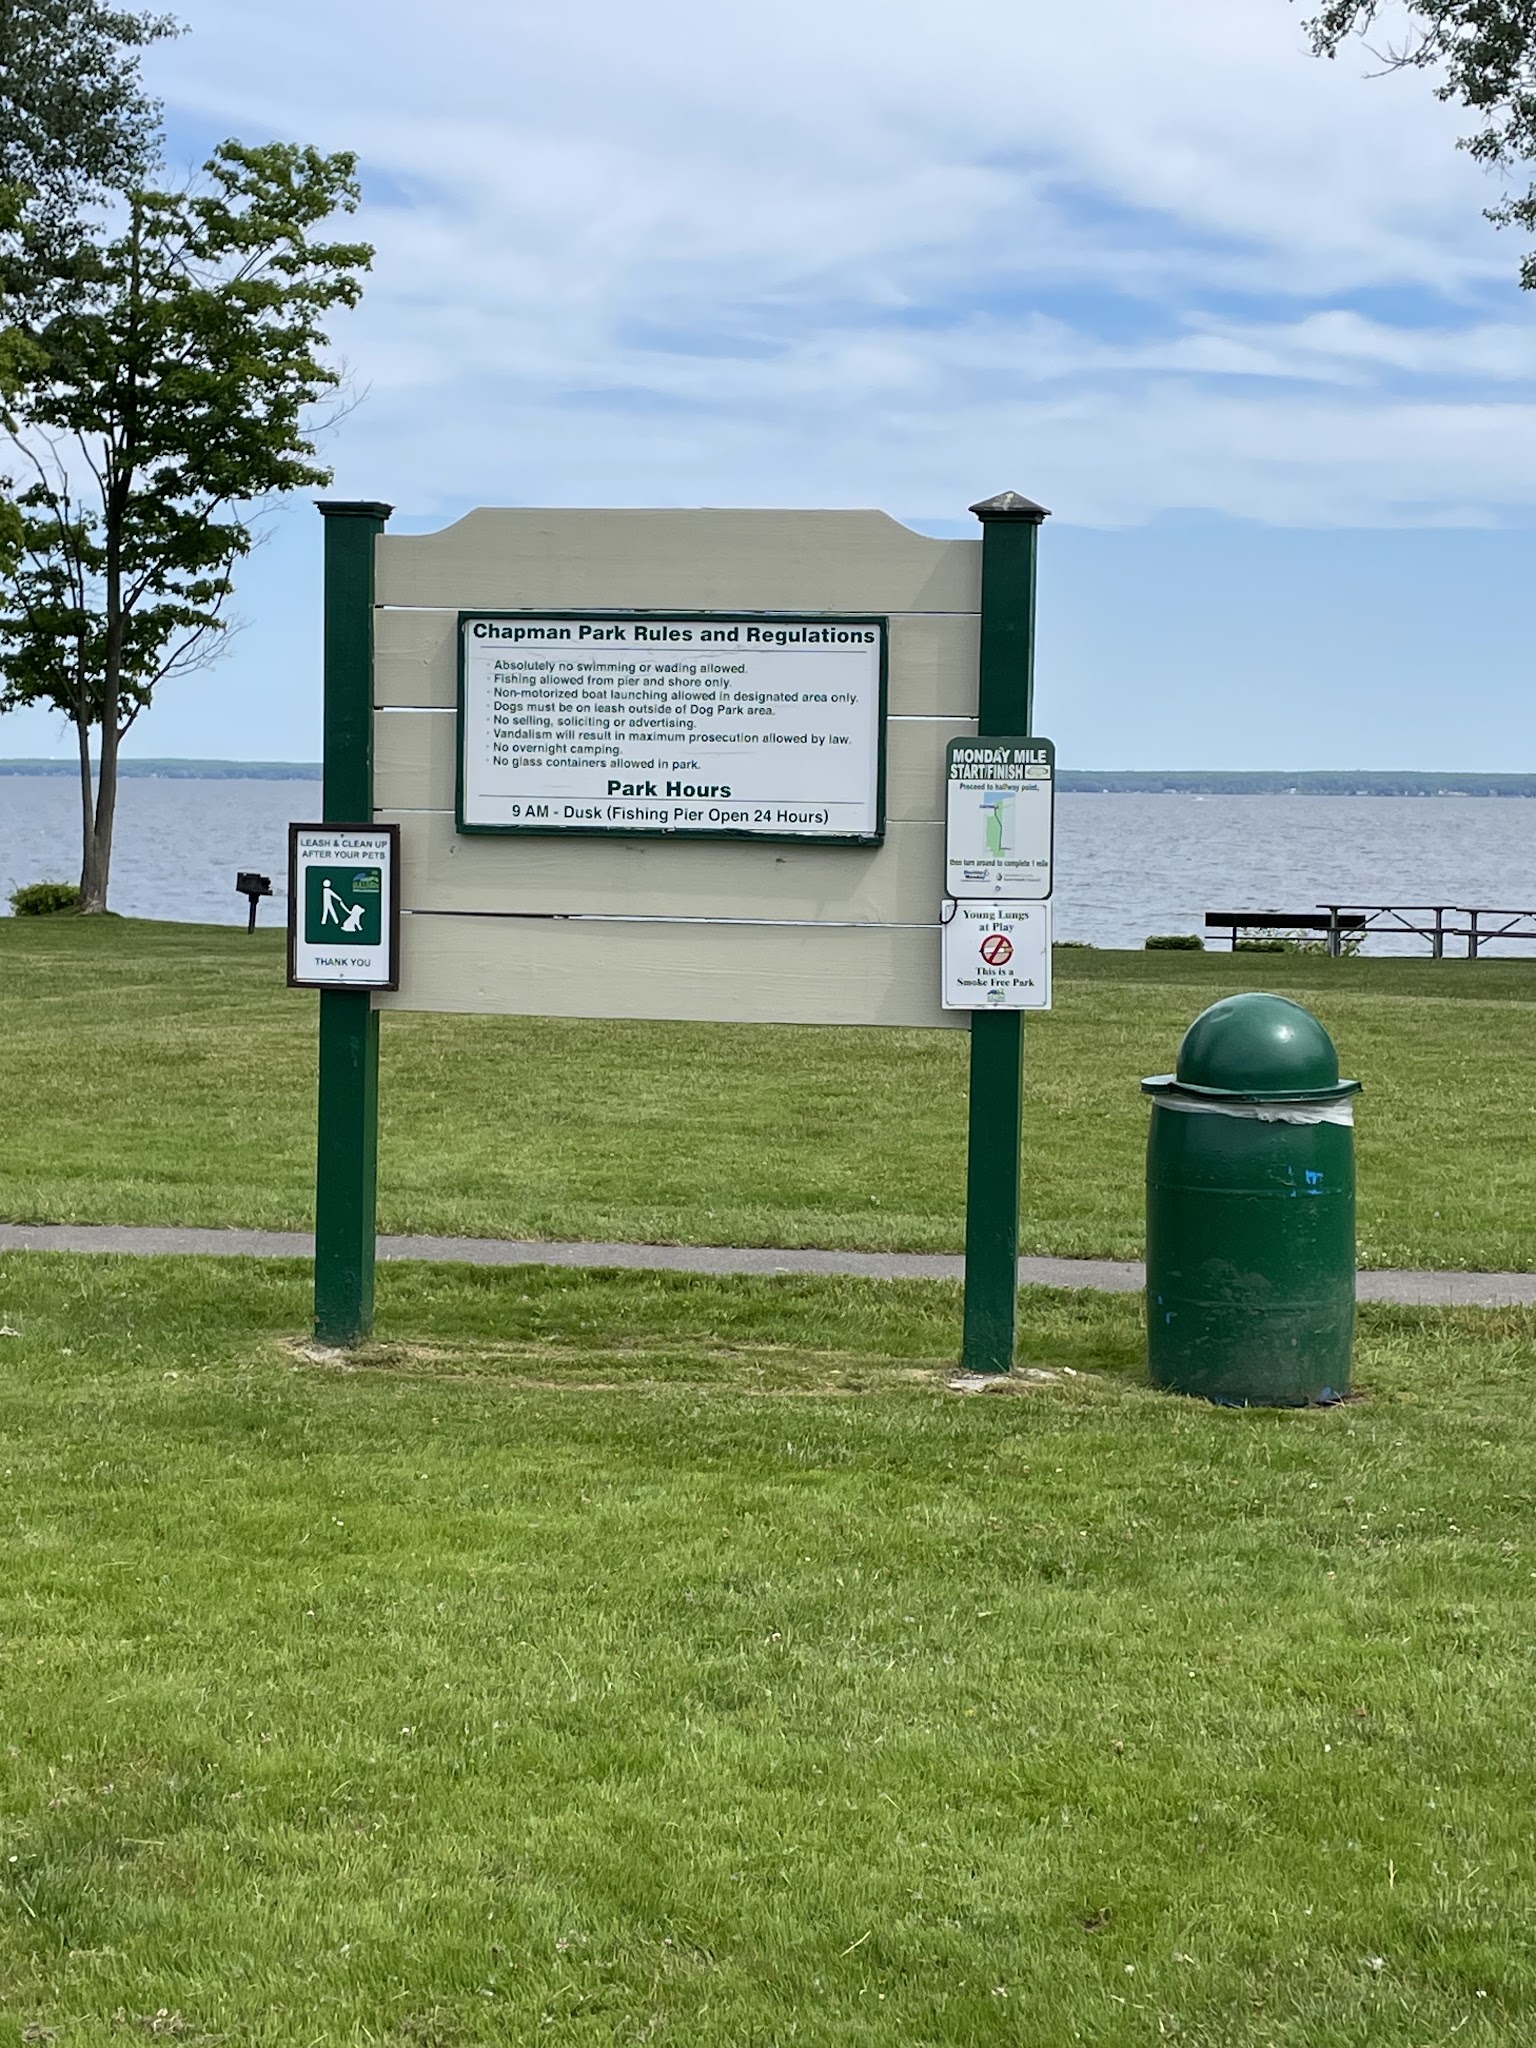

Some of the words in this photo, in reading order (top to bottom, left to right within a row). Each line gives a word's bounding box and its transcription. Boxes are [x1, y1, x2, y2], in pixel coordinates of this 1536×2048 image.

[473, 623, 571, 642] Chapman
[579, 625, 626, 640] Park
[634, 626, 693, 641] Rules
[701, 627, 739, 642] and
[747, 627, 875, 645] Regulations
[494, 660, 555, 673] Absolutely
[577, 662, 635, 674] swimming
[639, 664, 651, 672] or
[655, 663, 696, 675] wading
[700, 664, 748, 673] allowed.
[494, 674, 536, 686] Fishing
[540, 675, 583, 685] allowed
[587, 676, 613, 685] from
[618, 677, 639, 687] pier
[644, 677, 664, 686] and
[669, 678, 701, 686] shore
[705, 678, 731, 689] only.
[494, 688, 578, 699] Non-motorized
[582, 689, 607, 699] boat
[611, 690, 667, 702] launching
[671, 691, 715, 700] allowed
[720, 691, 729, 701] in
[734, 692, 798, 703] designated
[802, 694, 827, 702] area
[494, 702, 523, 713] Dogs
[527, 703, 555, 712] must
[559, 703, 573, 712] be
[595, 704, 624, 713] leash
[629, 705, 671, 714] outside
[675, 705, 687, 714] of
[691, 705, 713, 716] Dog
[718, 705, 743, 715] Park
[747, 707, 775, 715] area.
[494, 716, 509, 724] No
[513, 716, 553, 727] selling,
[558, 717, 609, 728] soliciting
[629, 718, 696, 730] advertising.
[494, 729, 552, 739] Vandalism
[556, 730, 574, 739] will
[579, 731, 611, 740] result
[615, 732, 625, 740] in
[629, 733, 685, 741] maximum
[689, 732, 759, 744] prosecution
[762, 733, 807, 743] allowed
[811, 734, 825, 746] by
[829, 735, 851, 744] law.
[493, 743, 508, 752] No
[513, 743, 567, 755] overnight
[570, 745, 622, 756] camping.
[953, 749, 1010, 763] MONDAY
[1015, 750, 1046, 763] MILE
[493, 756, 508, 765] No
[512, 757, 542, 768] glass
[546, 758, 606, 768] containers
[610, 759, 654, 768] allowed
[659, 759, 668, 768] in
[672, 760, 700, 771] park.
[608, 780, 657, 796] Park
[667, 782, 731, 797] Hours
[512, 805, 520, 816] 9
[525, 805, 549, 817] AM
[564, 806, 602, 819] Dusk
[607, 805, 668, 823] (Fishing
[674, 808, 704, 820] Pier
[709, 809, 749, 824] Open
[754, 810, 771, 821] 24
[778, 809, 828, 825] Hours)
[301, 839, 330, 847] LEASH
[963, 910, 995, 920] Young
[999, 910, 1029, 920] Lungs
[993, 923, 1014, 933] Play
[315, 958, 348, 966] THANK
